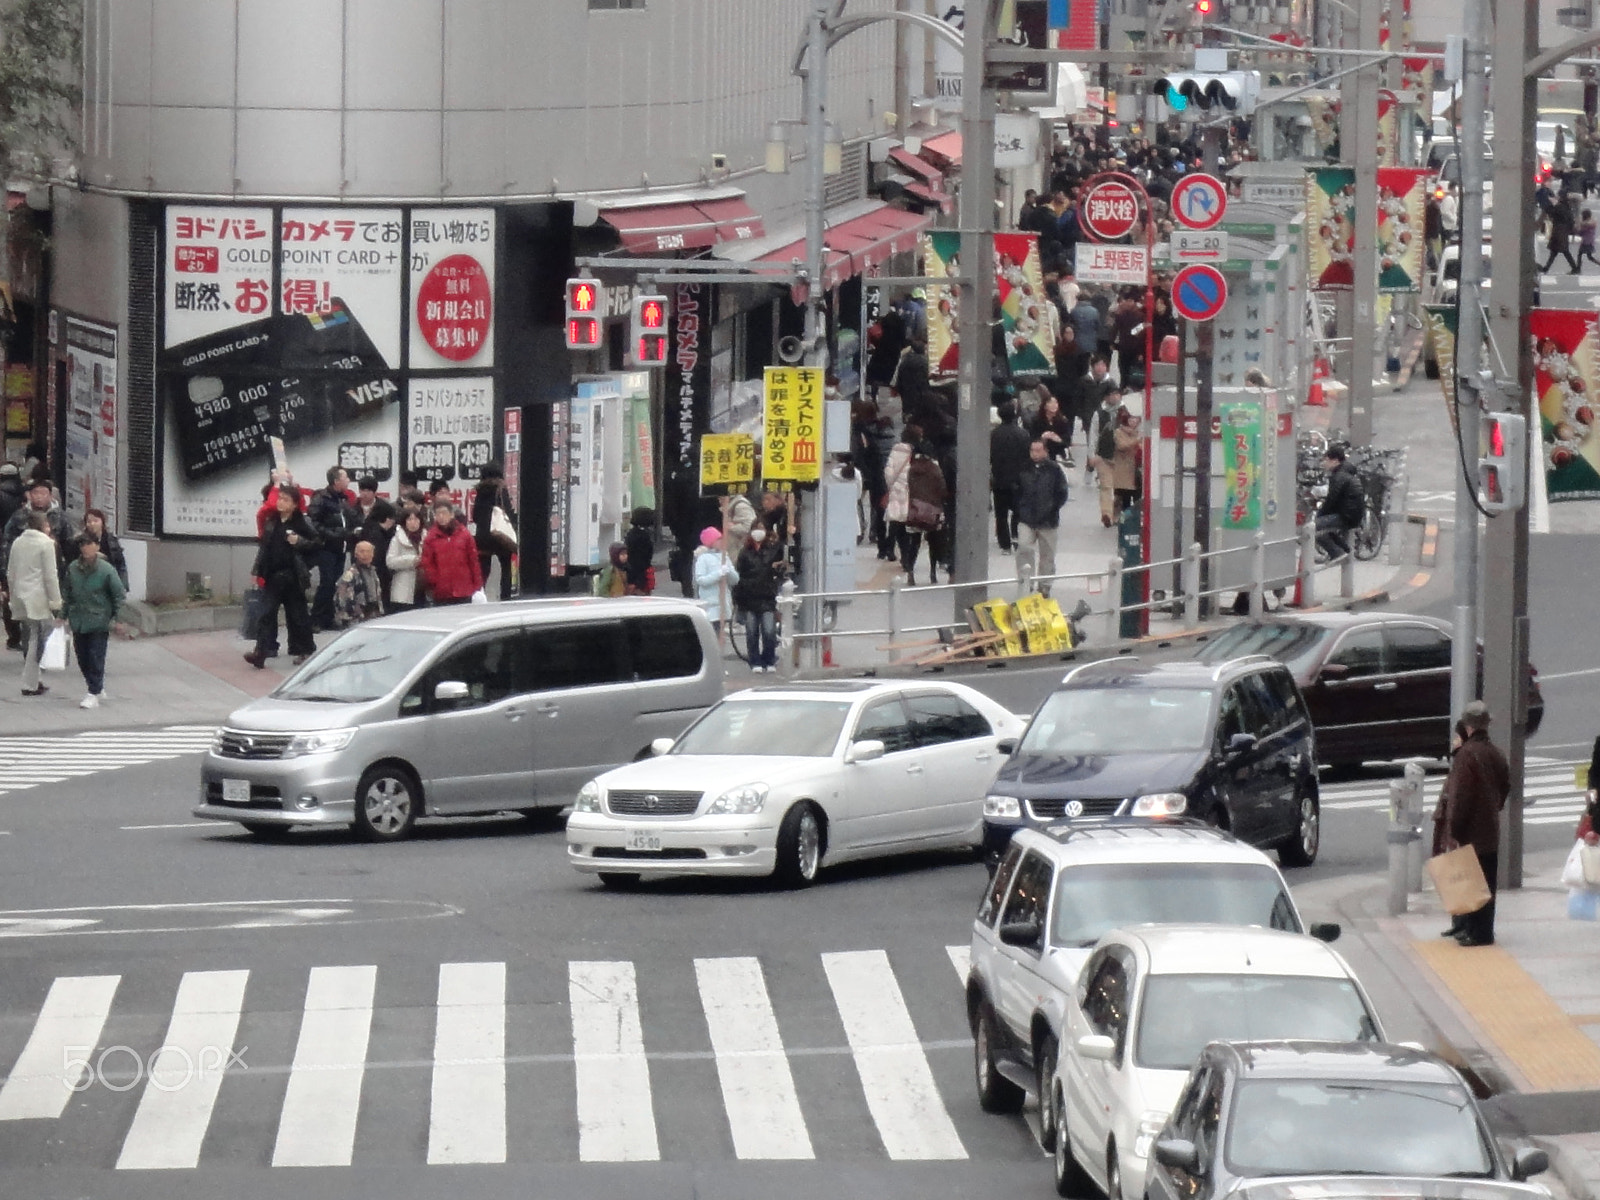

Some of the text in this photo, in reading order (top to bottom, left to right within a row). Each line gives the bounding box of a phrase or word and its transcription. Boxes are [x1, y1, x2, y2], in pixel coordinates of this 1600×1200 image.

[1091, 200, 1133, 220] 消火栓
[187, 261, 205, 272] より
[227, 248, 271, 263] GOLD
[282, 249, 332, 264] POINT
[337, 250, 381, 265] CARD
[1090, 249, 1144, 271] 上野医院
[445, 278, 470, 294] 無料
[426, 300, 485, 320] 新規会員
[436, 327, 479, 347] 募集中
[182, 353, 206, 366] GOLD
[206, 344, 233, 359] POINT
[235, 336, 260, 350] CARD
[346, 378, 398, 405] VISA
[791, 371, 817, 464] キリストの血
[1230, 433, 1250, 523] スクラッチ
